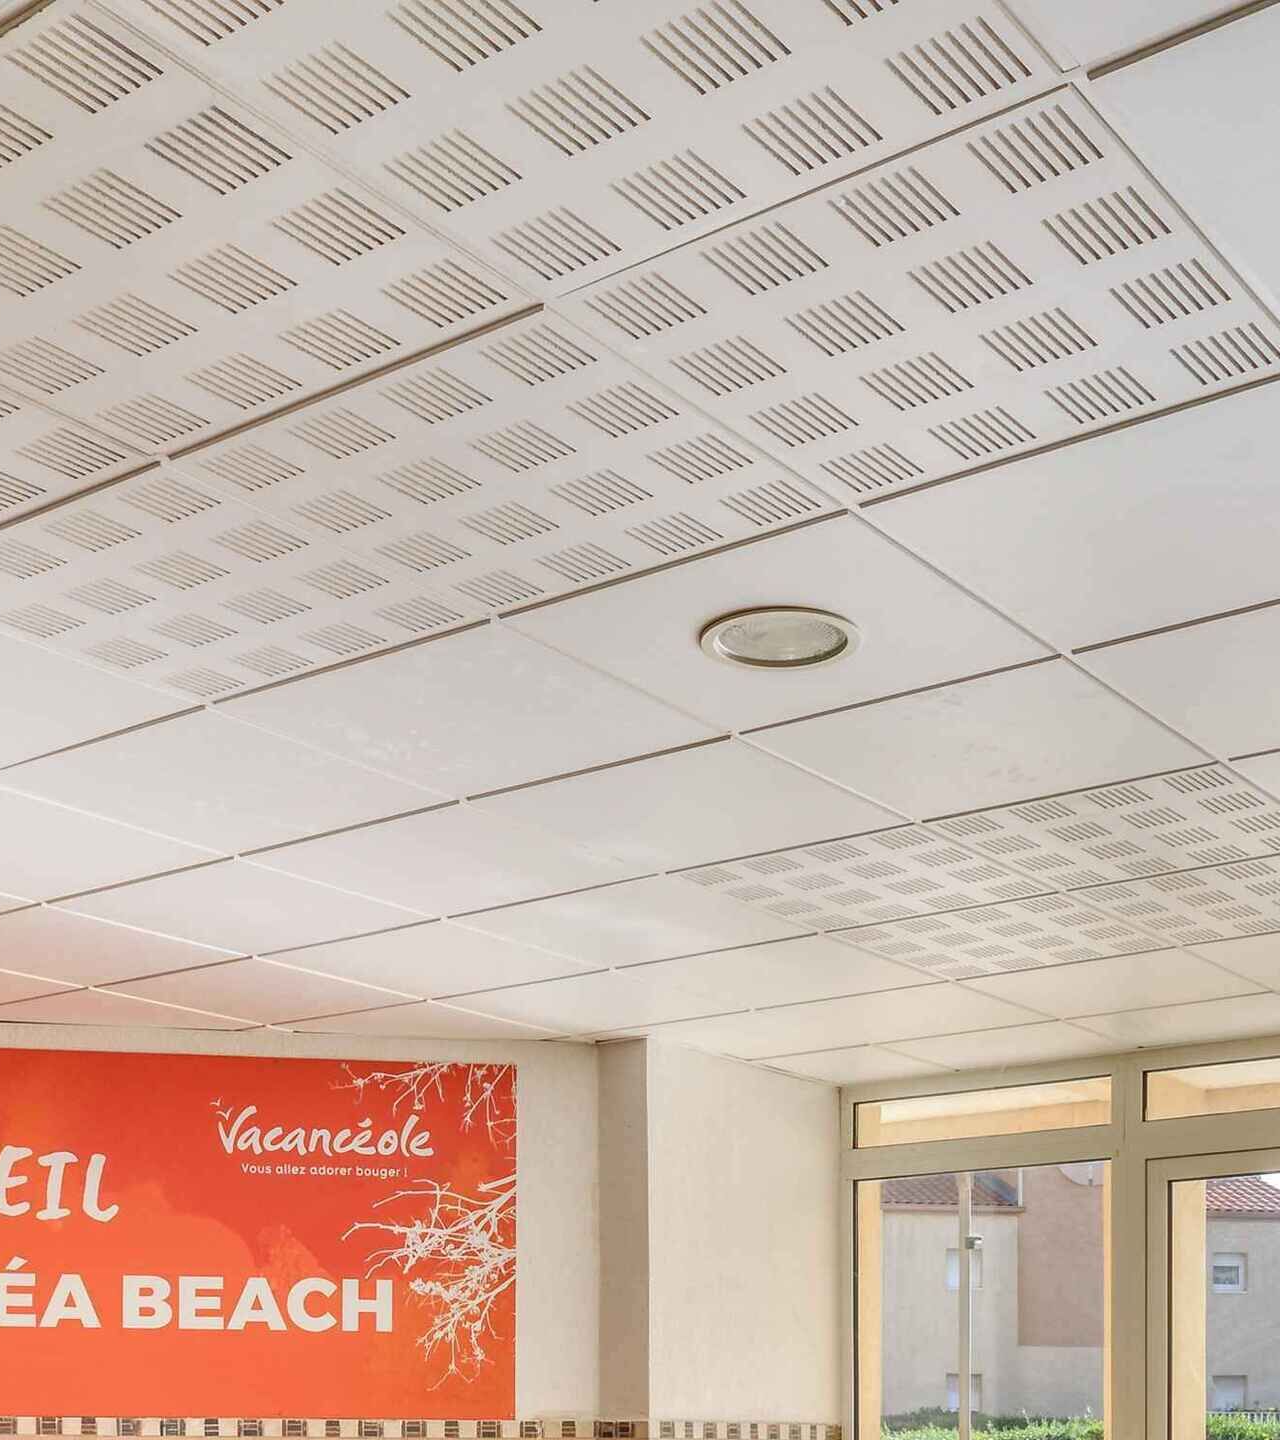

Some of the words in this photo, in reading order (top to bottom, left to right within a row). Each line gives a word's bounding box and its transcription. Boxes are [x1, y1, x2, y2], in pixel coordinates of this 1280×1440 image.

[218, 1105, 434, 1157] Vacancéole
[241, 1162, 273, 1175] Vous
[275, 1163, 307, 1175] allez
[309, 1164, 353, 1177] adorer
[355, 1164, 401, 1180] bouger
[121, 1273, 394, 1334] BEACH
